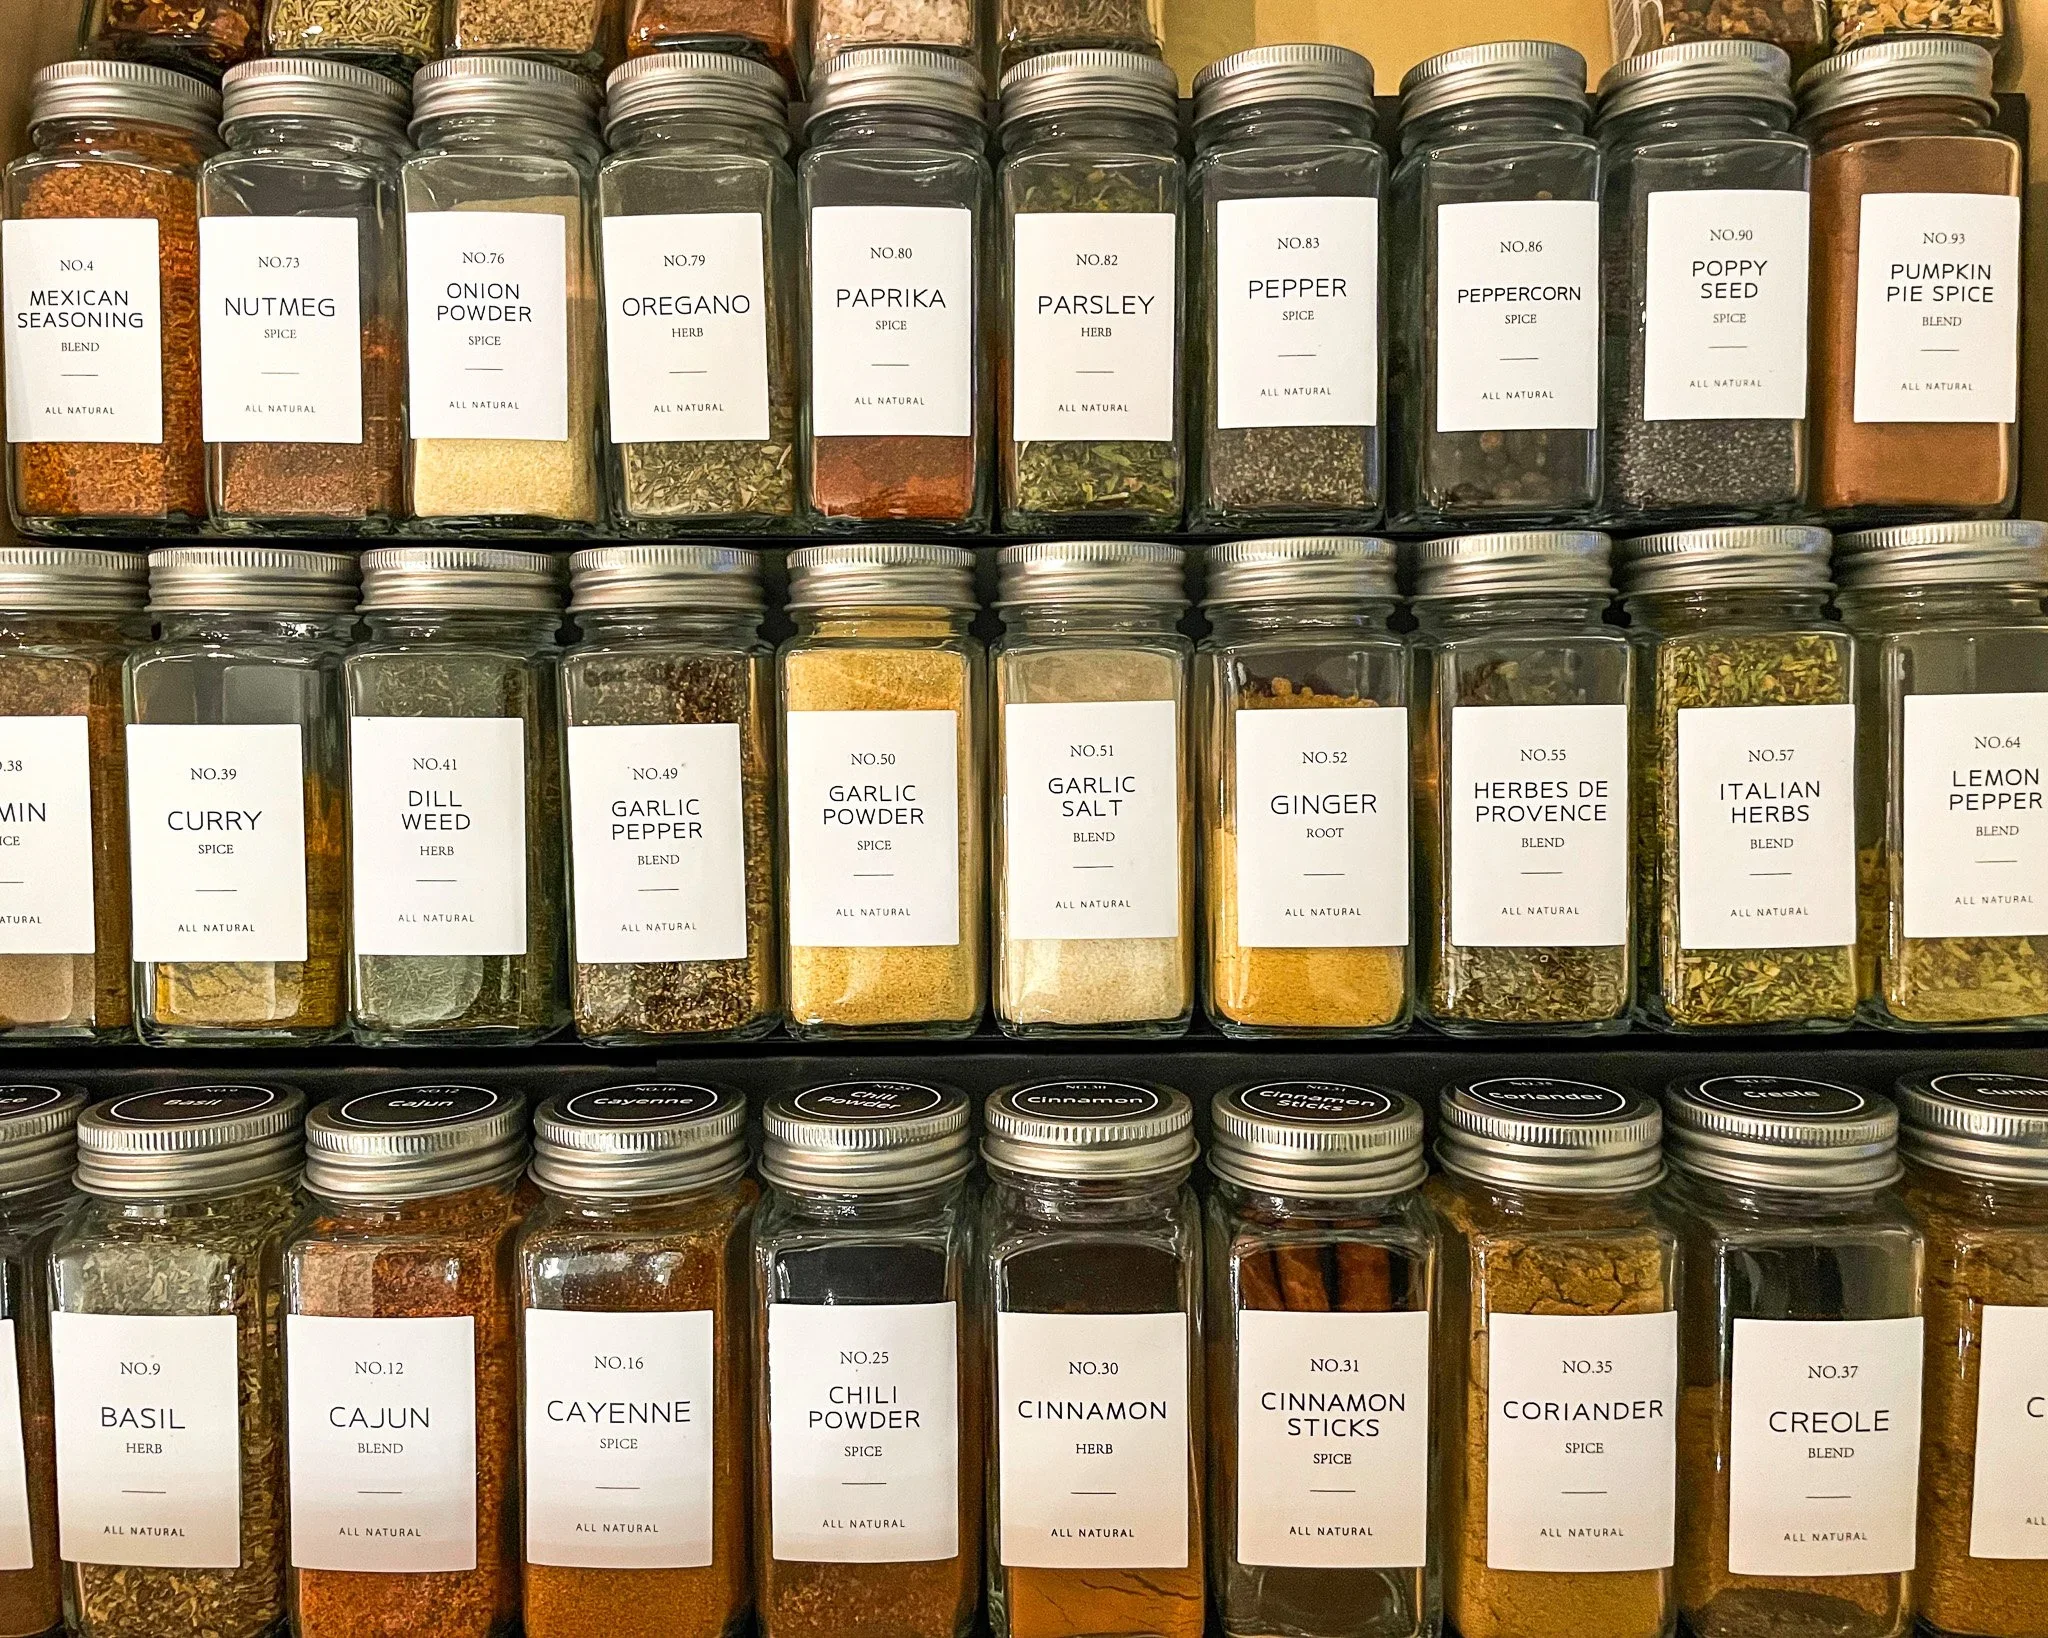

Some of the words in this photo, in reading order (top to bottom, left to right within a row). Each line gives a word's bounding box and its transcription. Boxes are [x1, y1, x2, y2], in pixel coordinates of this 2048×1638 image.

[1709, 228, 1754, 242] NO.90
[1922, 231, 1966, 245] NO.93
[1276, 236, 1320, 250] NO.83
[1499, 240, 1543, 254] NO.86
[462, 251, 505, 265] NO.76
[869, 246, 913, 260] NO.80
[1075, 253, 1119, 267] NO.82
[59, 259, 94, 272] NO.4
[258, 256, 300, 269] NO.73
[663, 254, 706, 268] NO.79
[1692, 259, 1769, 278] POPPY
[1890, 262, 1992, 281] PUMPKIN
[446, 282, 520, 300] ONION
[1248, 277, 1347, 300] PEPPER
[1457, 285, 1582, 304] PEPPERCORN
[1700, 281, 1759, 300] SEED
[1886, 285, 1924, 303] PIE
[1932, 285, 1995, 304] SPICE
[29, 289, 129, 307] MEXICAN
[836, 287, 947, 309] PAPRIKA
[1038, 294, 1156, 315] PARSLEY
[224, 296, 336, 318] NUTMEG
[622, 294, 751, 317] OREGANO
[17, 311, 144, 329] SEASONING
[437, 304, 533, 323] POWDER
[1282, 309, 1315, 321] SPICE
[1504, 313, 1538, 325] SPICE
[1712, 312, 1747, 324] SPICE
[875, 319, 908, 331] SPICE
[1921, 315, 1963, 327] BLEND
[263, 328, 297, 339] SPICE
[671, 327, 704, 338] HERB
[1081, 326, 1113, 338] HERB
[60, 341, 100, 353] BLEND
[468, 335, 502, 346] SPICE
[1260, 388, 1279, 397] ALL
[1283, 386, 1332, 396] NATURAL
[1900, 382, 1920, 391] ALL
[1925, 382, 1973, 391] NATURAL
[854, 396, 873, 406] ALL
[877, 396, 925, 406] NATURAL
[1481, 391, 1501, 401] ALL
[1505, 390, 1555, 400] NATURAL
[44, 406, 63, 415] ALL
[66, 406, 115, 415] NATURAL
[245, 404, 263, 413] ALL
[267, 404, 316, 414] NATURAL
[449, 400, 467, 409] ALL
[471, 400, 520, 410] NATURAL
[653, 404, 672, 413] ALL
[676, 402, 725, 412] NATURAL
[1058, 403, 1077, 413] ALL
[1081, 403, 1129, 413] NATURAL
[1973, 735, 2021, 750] NO.64
[1069, 744, 1114, 758] NO.51
[1301, 750, 1348, 765] NO.52
[1520, 748, 1567, 762] NO.55
[1747, 748, 1795, 763] NO.57
[412, 757, 458, 771] NO.41
[850, 752, 896, 766] NO.50
[190, 767, 237, 781] NO.39
[632, 767, 679, 781] NO.49
[1952, 767, 2040, 788] LEMON
[1048, 775, 1136, 795] GARLIC
[1474, 780, 1568, 800] HERBES
[1578, 780, 1609, 799] DE
[1720, 779, 1821, 801] ITALIAN
[408, 789, 463, 808] DILL
[828, 784, 917, 803] GARLIC
[611, 798, 700, 818] GARLIC
[1270, 793, 1377, 815] GINGER
[1949, 791, 2044, 811] PEPPER
[1061, 799, 1124, 818] SALT
[1475, 803, 1608, 823] PROVENCE
[1731, 804, 1810, 824] HERBS
[167, 810, 263, 831] CURRY
[401, 813, 471, 831] WEED
[823, 807, 925, 826] POWDER
[611, 821, 703, 841] PEPPER
[1072, 831, 1116, 843] BLEND
[1306, 827, 1345, 839] ROOT
[1975, 825, 2020, 837] BLEND
[197, 843, 235, 855] SPICE
[856, 839, 892, 851] SPICE
[1520, 837, 1565, 849] BLEND
[1750, 837, 1794, 850] BLEND
[419, 845, 455, 857] HERB
[637, 853, 680, 866] BLEND
[1055, 900, 1076, 910] ALL
[1080, 899, 1132, 909] NATURAL
[1501, 907, 1521, 916] ALL
[1527, 906, 1580, 916] NATURAL
[835, 908, 855, 917] ALL
[860, 907, 911, 917] NATURAL
[1284, 908, 1305, 917] ALL
[1310, 907, 1362, 917] NATURAL
[177, 923, 198, 933] ALL
[203, 923, 256, 933] NATURAL
[593, 1097, 694, 1106] Cayenne
[849, 1090, 899, 1101] Chili
[1026, 1095, 1144, 1104] Cinnamon
[1258, 1089, 1376, 1108] Cinnamon
[1487, 1091, 1603, 1101] Coriander
[387, 1099, 454, 1108] Cajun
[594, 1355, 644, 1370] NO.16
[839, 1350, 889, 1365] NO.25
[119, 1361, 161, 1376] NO.9
[354, 1361, 404, 1375] NO.12
[1068, 1361, 1119, 1376] NO.30
[1309, 1358, 1360, 1373] NO.31
[1561, 1359, 1613, 1375] NO.35
[1807, 1364, 1859, 1380] NO.37
[828, 1385, 897, 1405] CHILI
[1260, 1391, 1406, 1414] CINNAMON
[329, 1405, 430, 1429] CAJUN
[546, 1399, 692, 1424] CAYENNE
[1017, 1399, 1167, 1421] CINNAMON
[1502, 1399, 1664, 1422] CORIANDER
[101, 1406, 187, 1430] BASIL
[808, 1409, 921, 1430] POWDER
[1768, 1409, 1891, 1434] CREOLE
[1287, 1417, 1380, 1438] STICKS
[125, 1442, 163, 1455] HERB
[357, 1442, 404, 1455] BLEND
[599, 1437, 639, 1450] SPICE
[1075, 1443, 1114, 1455] HERB
[1564, 1441, 1605, 1455] SPICE
[843, 1445, 883, 1458] SPICE
[1312, 1452, 1353, 1465] SPICE
[1807, 1446, 1855, 1460] BLEND
[575, 1522, 597, 1533] ALL
[602, 1523, 660, 1534] NATURAL
[822, 1519, 845, 1529] ALL
[849, 1518, 906, 1529] NATURAL
[103, 1524, 125, 1536] ALL
[130, 1526, 186, 1538] NATURAL
[338, 1526, 360, 1537] ALL
[365, 1527, 422, 1538] NATURAL
[1050, 1528, 1073, 1538] ALL
[1078, 1528, 1135, 1538] NATURAL
[1289, 1525, 1312, 1537] ALL
[1317, 1526, 1374, 1537] NATURAL
[1539, 1527, 1563, 1538] ALL
[1568, 1527, 1624, 1538] NATURAL
[1783, 1532, 1807, 1543] ALL
[1811, 1531, 1868, 1542] NATURAL
